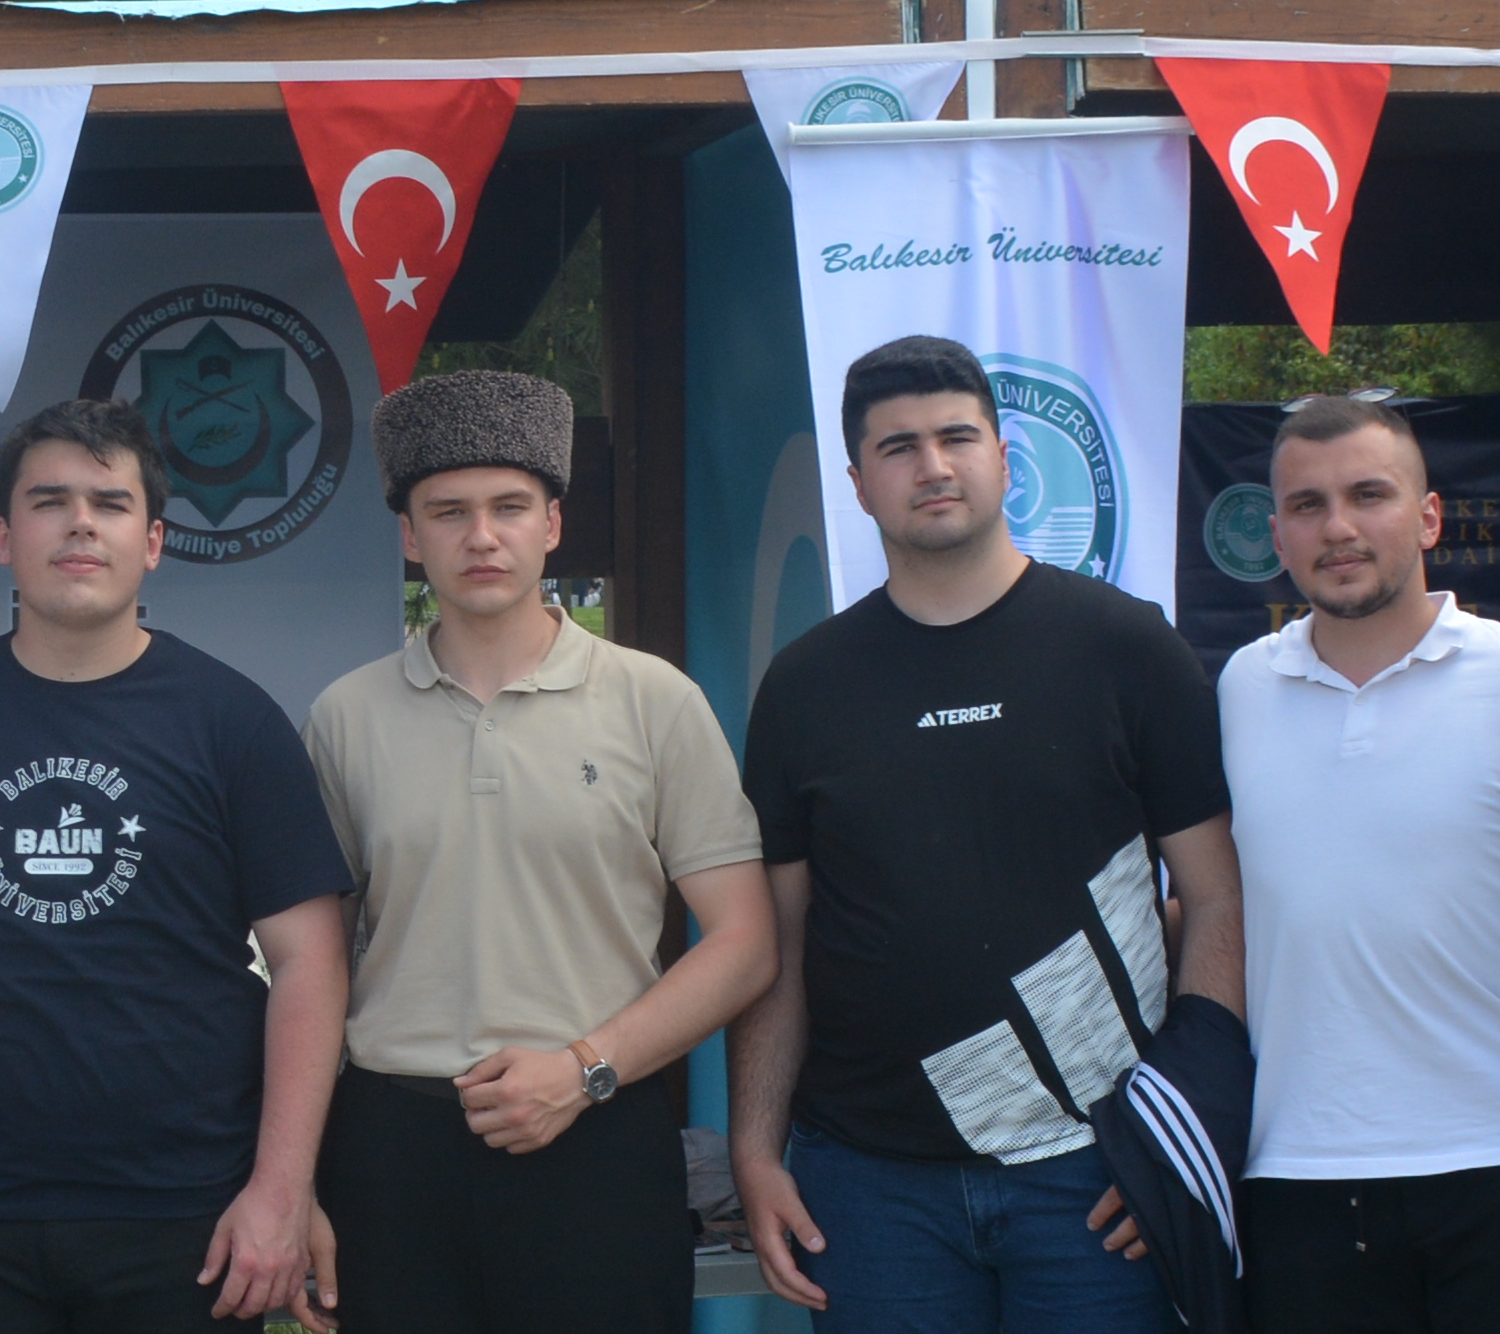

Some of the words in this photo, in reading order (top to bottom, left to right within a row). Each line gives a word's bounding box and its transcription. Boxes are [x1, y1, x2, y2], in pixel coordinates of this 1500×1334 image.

[986, 226, 1165, 268] Üniversitesi
[996, 377, 1115, 508] ÜNİVERSİTESİ
[164, 527, 241, 560] Milliye
[246, 463, 339, 548] Topluluğu
[935, 702, 1003, 726] TERREX
[63, 861, 88, 872] 1992
